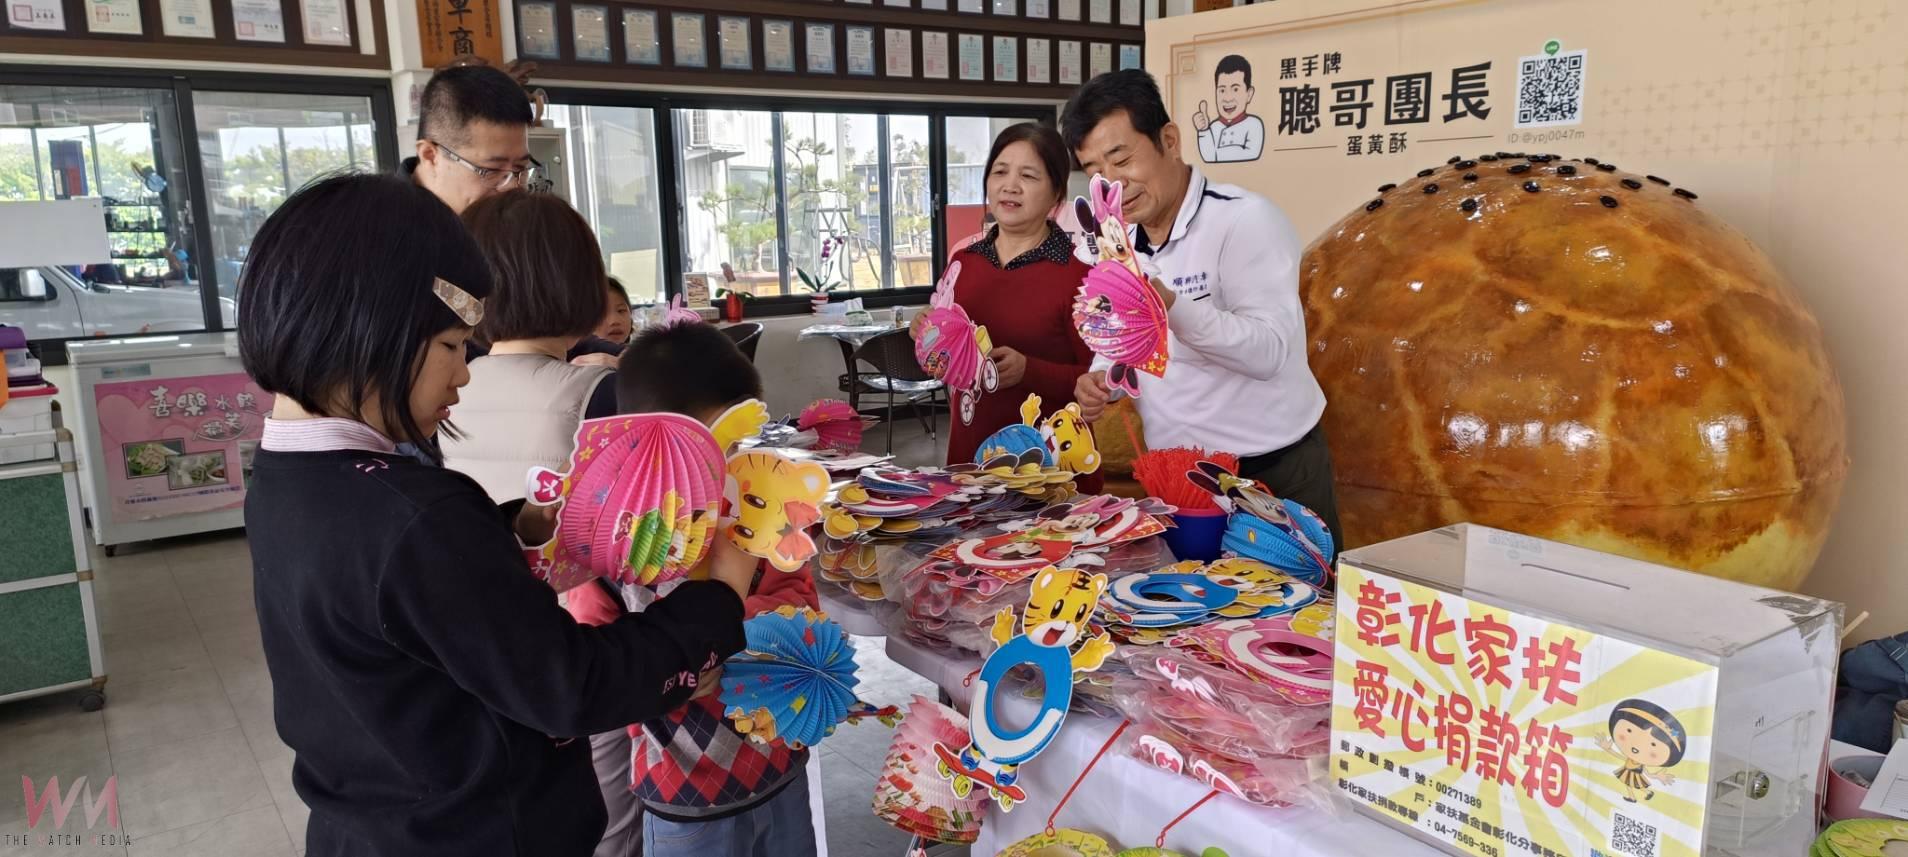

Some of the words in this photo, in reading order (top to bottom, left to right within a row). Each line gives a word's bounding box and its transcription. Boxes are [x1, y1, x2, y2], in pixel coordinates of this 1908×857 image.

[1278, 61, 1492, 135] 聰哥團長
[1280, 51, 1342, 79] 黑手牌
[1347, 132, 1407, 155] 蛋黃酥
[1356, 579, 1582, 706] 彰化家扶
[1353, 660, 1574, 807] 愛心捐款箱
